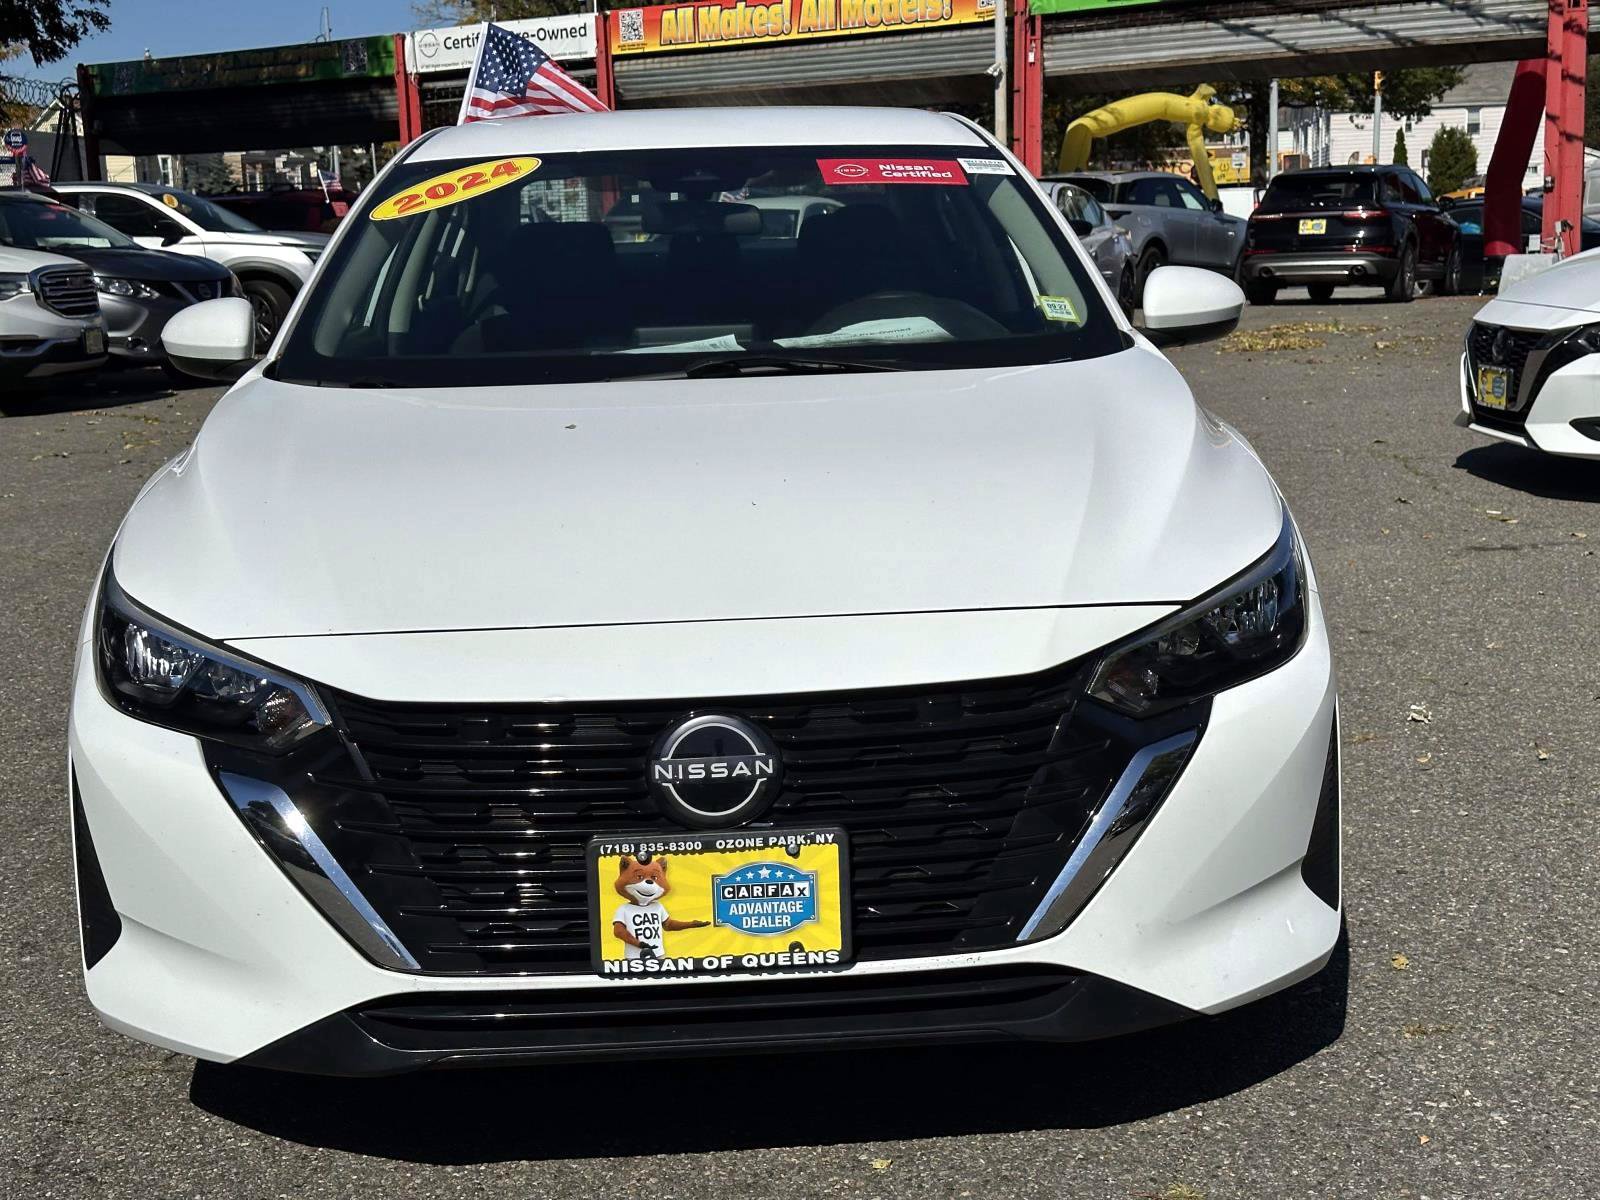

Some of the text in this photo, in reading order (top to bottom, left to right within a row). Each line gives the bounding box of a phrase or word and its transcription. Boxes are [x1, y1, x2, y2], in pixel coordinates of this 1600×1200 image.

[660, 6, 696, 46] All
[698, 0, 793, 42] Makes!
[798, 0, 837, 33] All
[878, 163, 934, 171] Nissan
[881, 170, 953, 178] Certified
[392, 160, 521, 216] 2024
[654, 759, 774, 780] NISSAN
[600, 843, 635, 855] (718)
[640, 841, 703, 852] 835-8300
[715, 837, 764, 849] OZONE
[815, 833, 835, 844] NY
[723, 883, 809, 898] CARFAX
[729, 901, 804, 916] ADVANTAGE
[632, 912, 660, 926] CAR
[742, 915, 792, 929] DEALER
[634, 927, 660, 940] FOX
[603, 950, 840, 974] NISSAN OF QUEENS
